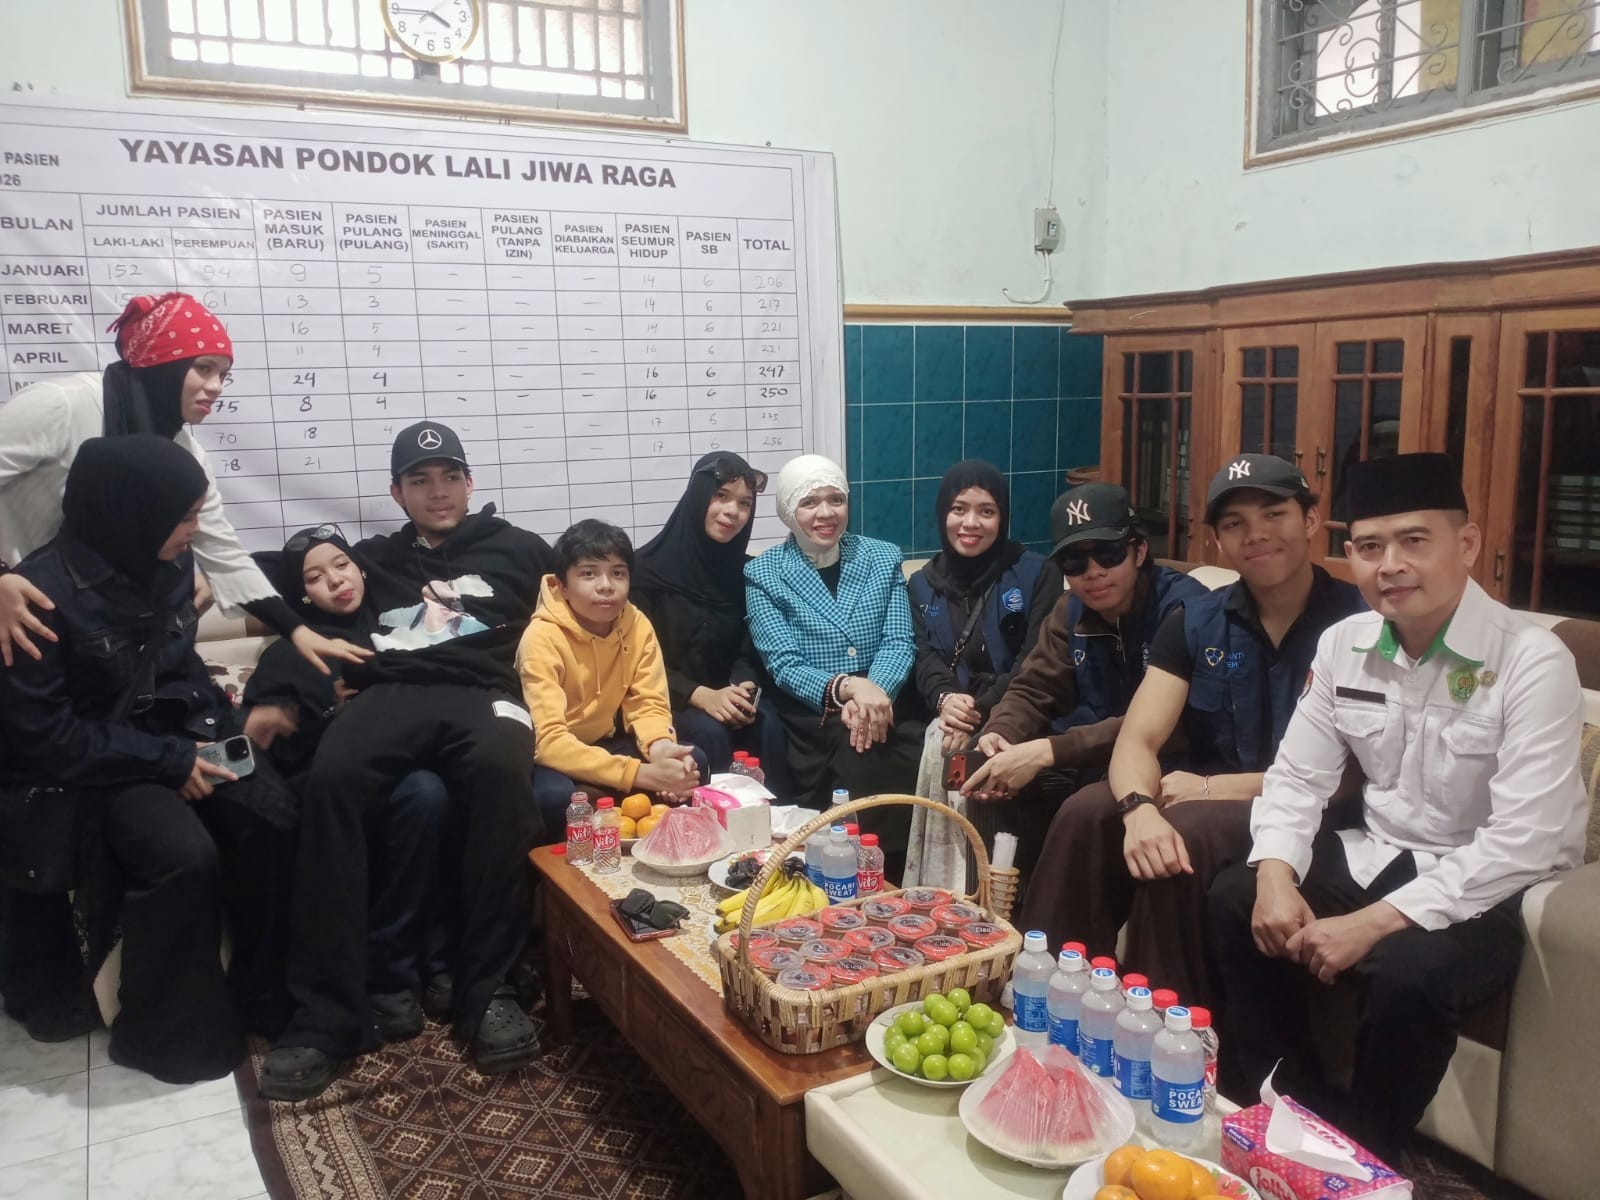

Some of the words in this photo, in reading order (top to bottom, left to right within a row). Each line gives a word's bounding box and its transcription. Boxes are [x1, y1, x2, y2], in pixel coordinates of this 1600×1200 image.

[459, 10, 467, 22] 3
[398, 21, 406, 33] 8
[454, 27, 462, 38] 4
[412, 34, 420, 45] 7
[427, 40, 435, 51] 6
[443, 37, 451, 49] 5
[5, 152, 60, 167] PASIEN
[119, 138, 284, 169] YAYASAN
[295, 147, 436, 176] PONDOK
[445, 155, 511, 180] LALI
[521, 160, 593, 185] JIWA
[601, 164, 677, 188] RAGA
[96, 204, 172, 218] JUMLAH
[178, 207, 241, 220] PASIEN
[263, 209, 322, 221] PASIEN
[0, 216, 73, 231] BULAN
[346, 213, 398, 225] PASIEN
[425, 219, 467, 229] PASIEN
[494, 214, 539, 224] PASIEN
[264, 223, 324, 236] MASUK
[343, 226, 403, 238] PULANG
[412, 229, 481, 240] MENINGGAL
[491, 226, 543, 235] PULANG
[564, 224, 603, 233] PASIEN
[625, 223, 670, 234] PASIEN
[496, 237, 541, 248] (TANPA
[554, 235, 614, 244] DIABAIKAN
[621, 236, 675, 247] SEUMUR
[686, 231, 731, 242] PASIEN
[93, 237, 164, 248] LAKI-LAKI
[174, 239, 255, 249] PEREMPUAN
[267, 238, 325, 251] (BARU)
[339, 239, 409, 252] (PULANG)
[426, 240, 469, 251] (SAKIT)
[744, 238, 791, 251] TOTAL
[505, 249, 532, 260] IZIN)
[555, 245, 615, 254] KELUARGA
[630, 249, 668, 258] HIDUP
[701, 245, 718, 254] SB
[1, 264, 84, 277] JANUARI
[108, 264, 142, 280] 152
[290, 264, 306, 281] 9
[367, 266, 383, 284] 5
[704, 273, 713, 287] 6
[4, 294, 88, 305] FEBRUARI
[286, 295, 309, 309] 13
[368, 296, 380, 308] 3
[644, 296, 655, 312] 14
[706, 300, 712, 311] 6
[758, 299, 781, 312] 217
[8, 323, 72, 335] MARET
[291, 321, 310, 335] 16
[704, 321, 714, 332] 6
[762, 322, 781, 333] 221
[708, 345, 714, 355] 6
[13, 352, 68, 364] APRIL
[223, 373, 234, 387] 3
[292, 372, 315, 388] 24
[373, 372, 387, 387] 4
[646, 367, 659, 379] 16
[706, 367, 716, 377] 6
[759, 365, 784, 378] 247
[300, 396, 312, 412] 8
[376, 396, 387, 410] 4
[645, 389, 657, 400] 16
[707, 389, 716, 397] 6
[760, 388, 788, 398] 250
[216, 431, 237, 445] 70
[304, 427, 317, 439] 18
[221, 459, 241, 472] 78
[304, 456, 321, 470] 21
[1228, 459, 1252, 481] NY
[1066, 498, 1091, 526] NY
[825, 882, 855, 891] POCARI
[825, 889, 853, 897] SWEAT
